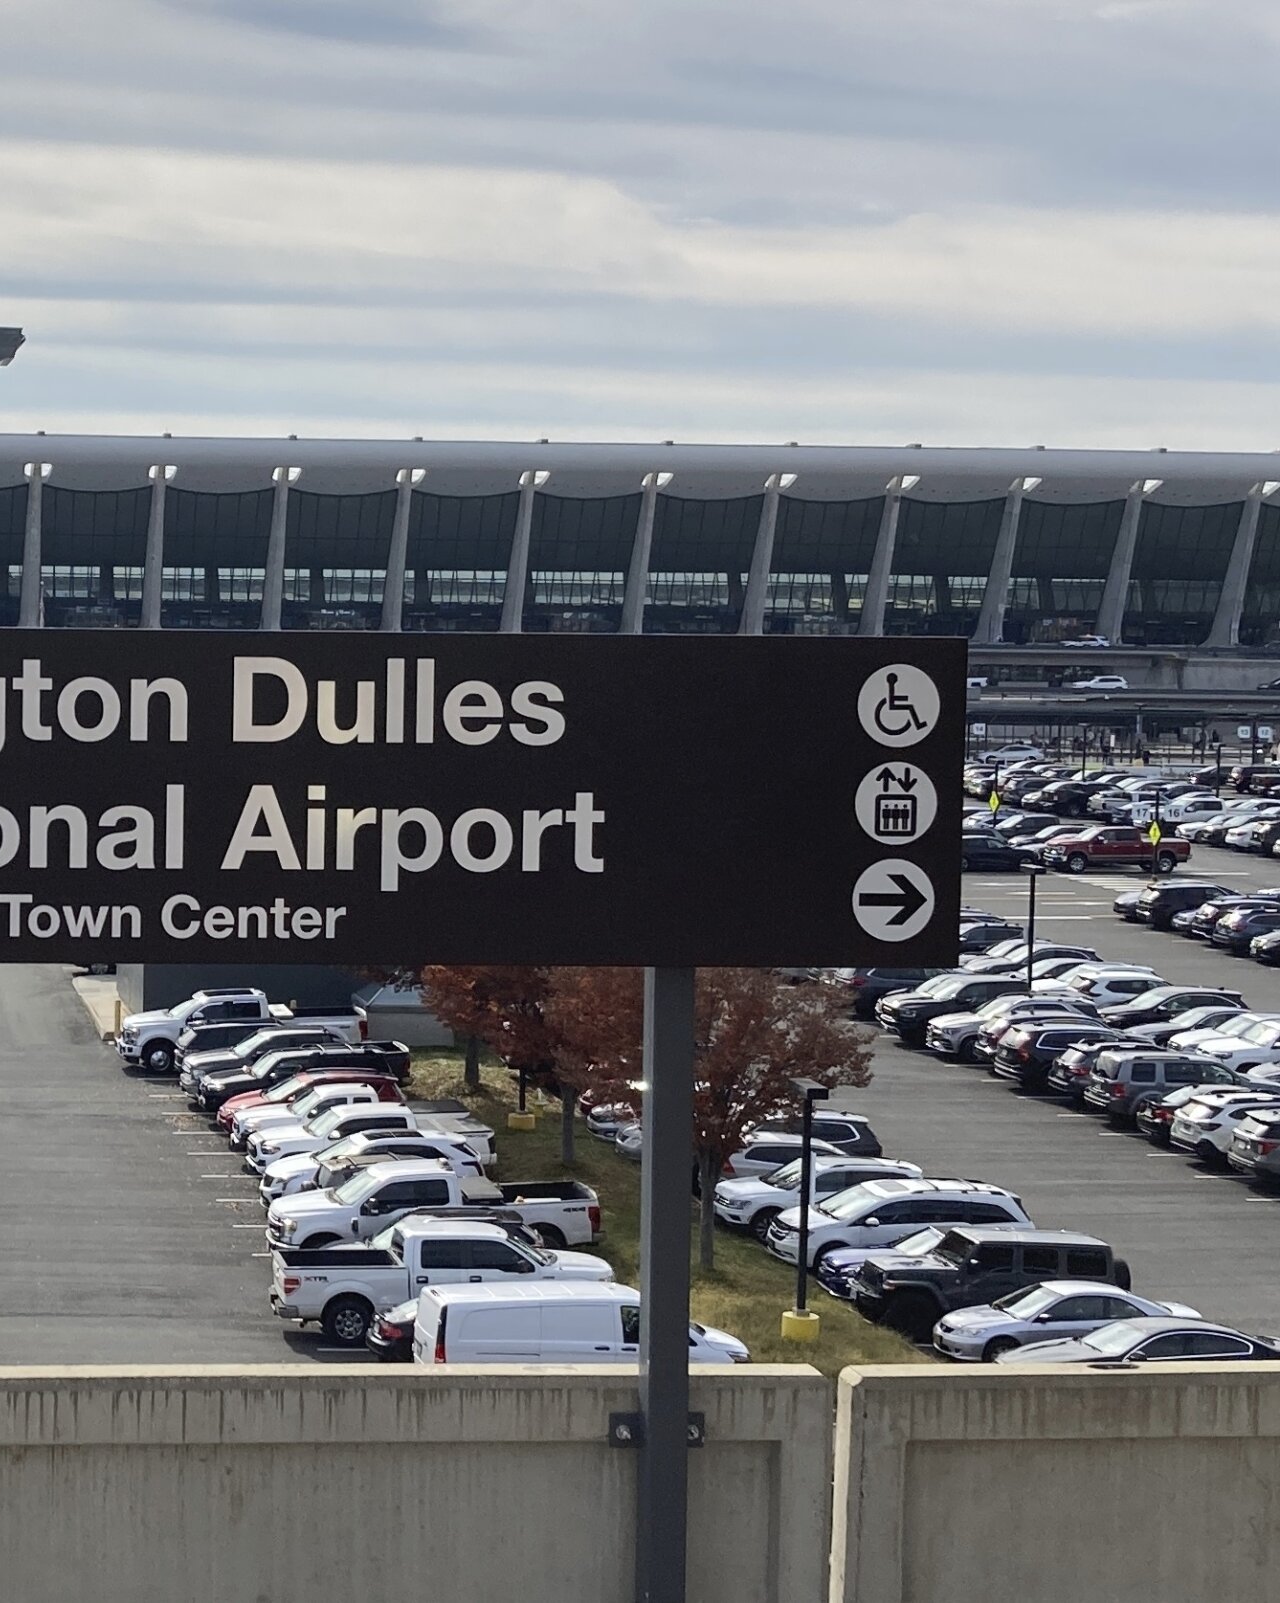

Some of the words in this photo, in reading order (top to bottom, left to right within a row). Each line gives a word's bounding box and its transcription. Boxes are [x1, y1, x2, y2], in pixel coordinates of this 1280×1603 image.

[231, 656, 567, 746] Dulles
[1136, 808, 1148, 817] 17
[1168, 809, 1180, 817] 16
[220, 784, 606, 892] Airport
[161, 893, 347, 940] Center
